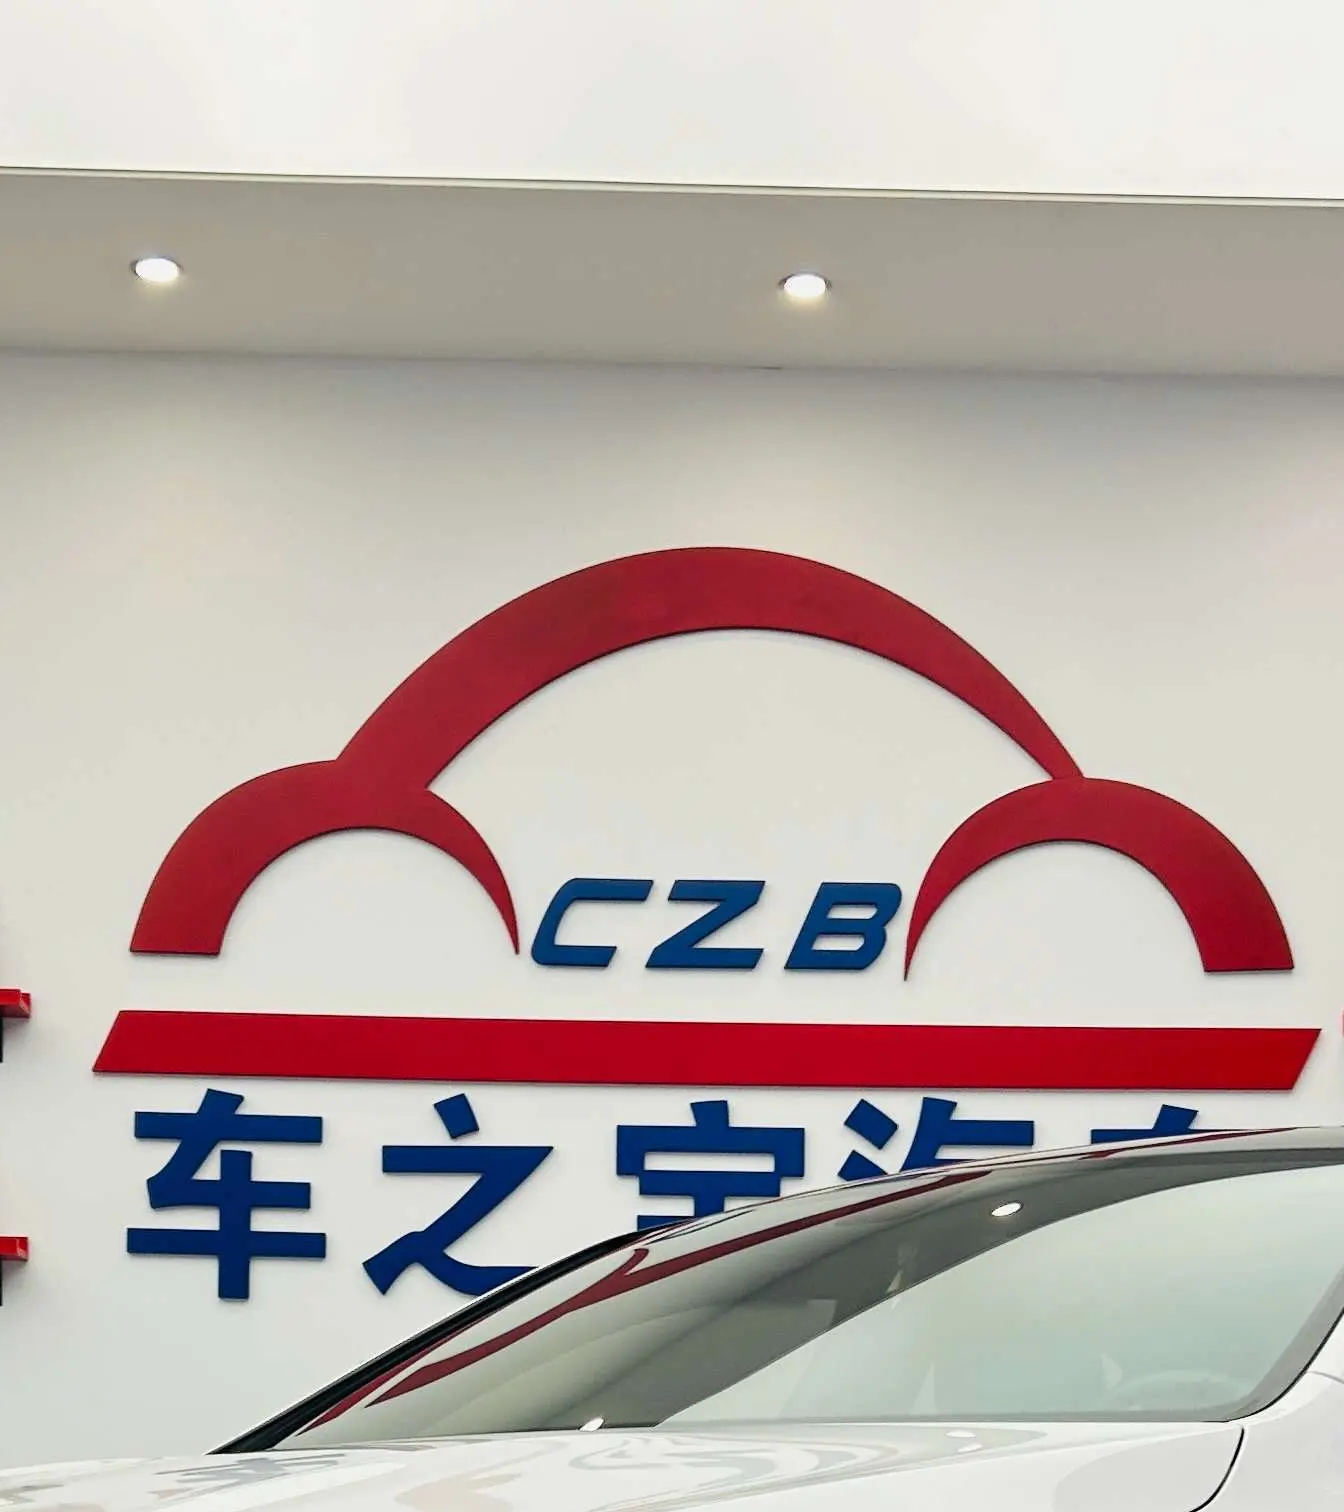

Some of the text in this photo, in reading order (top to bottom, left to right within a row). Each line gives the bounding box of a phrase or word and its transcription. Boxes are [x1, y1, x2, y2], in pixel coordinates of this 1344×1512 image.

[531, 877, 902, 970] CZB
[127, 1088, 1251, 1300] 车之宝
